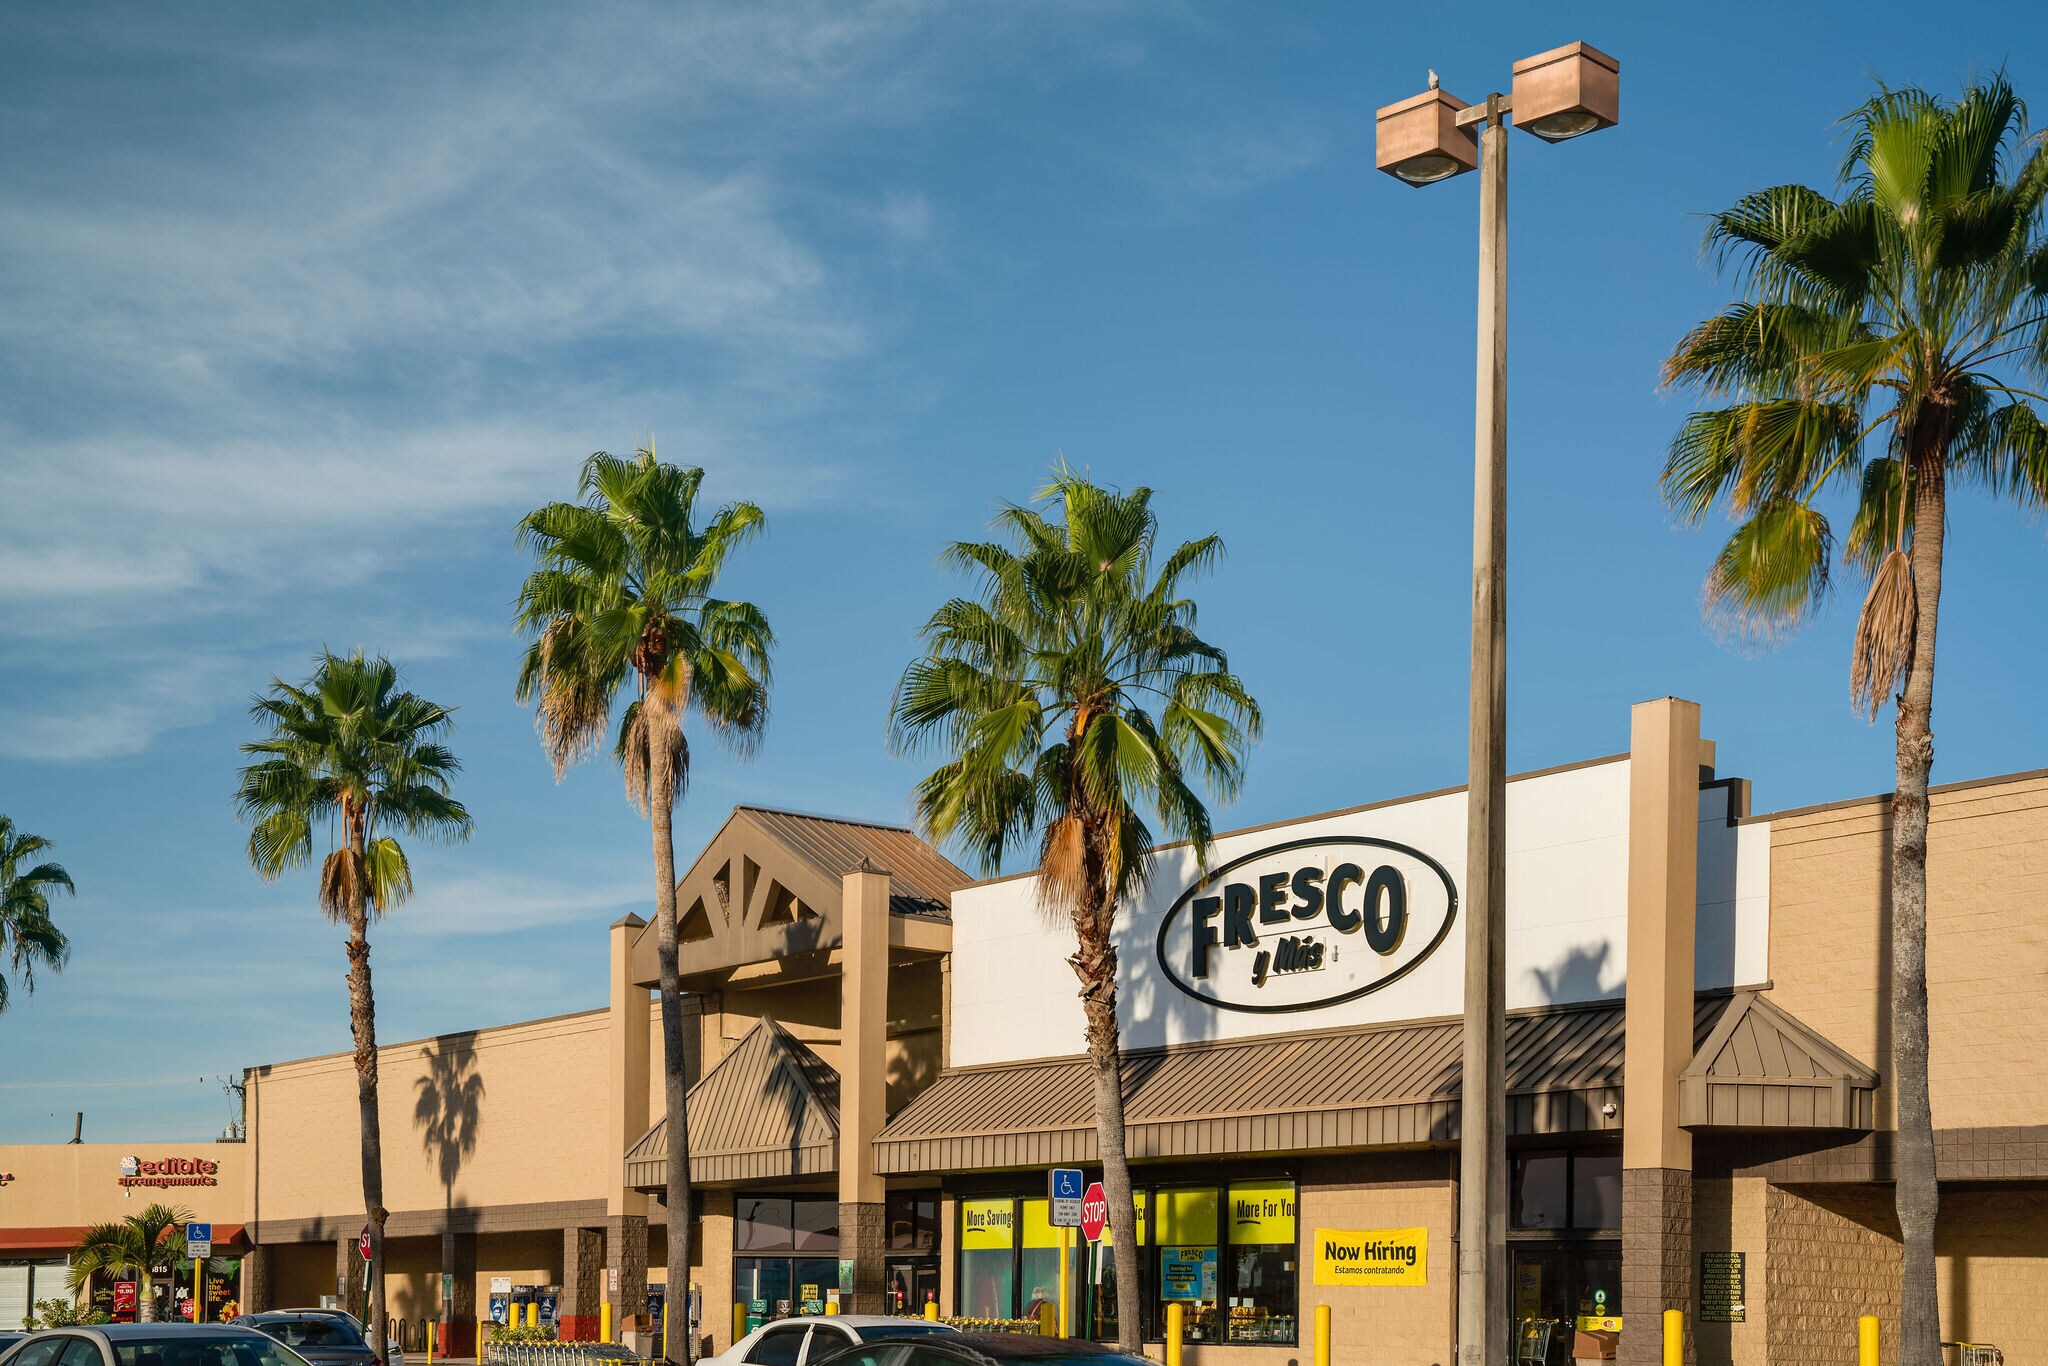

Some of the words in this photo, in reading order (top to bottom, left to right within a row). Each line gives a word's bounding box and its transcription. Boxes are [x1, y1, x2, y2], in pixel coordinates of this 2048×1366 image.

[1192, 862, 1409, 979] FRESCO
[1251, 950, 1271, 988] y
[140, 1156, 215, 1175] edible
[118, 1175, 215, 1189] arrangements
[1083, 1200, 1105, 1224] STOP
[1236, 1199, 1260, 1218] More
[1263, 1199, 1278, 1218] For
[966, 1209, 985, 1227] More
[361, 1233, 371, 1248] ST
[1180, 1249, 1203, 1260] FRESCO
[1324, 1241, 1361, 1261] Now
[1364, 1240, 1417, 1267] Hiring
[1334, 1265, 1363, 1275] Estamos
[1363, 1265, 1405, 1275] contratando
[208, 1277, 225, 1285] Live
